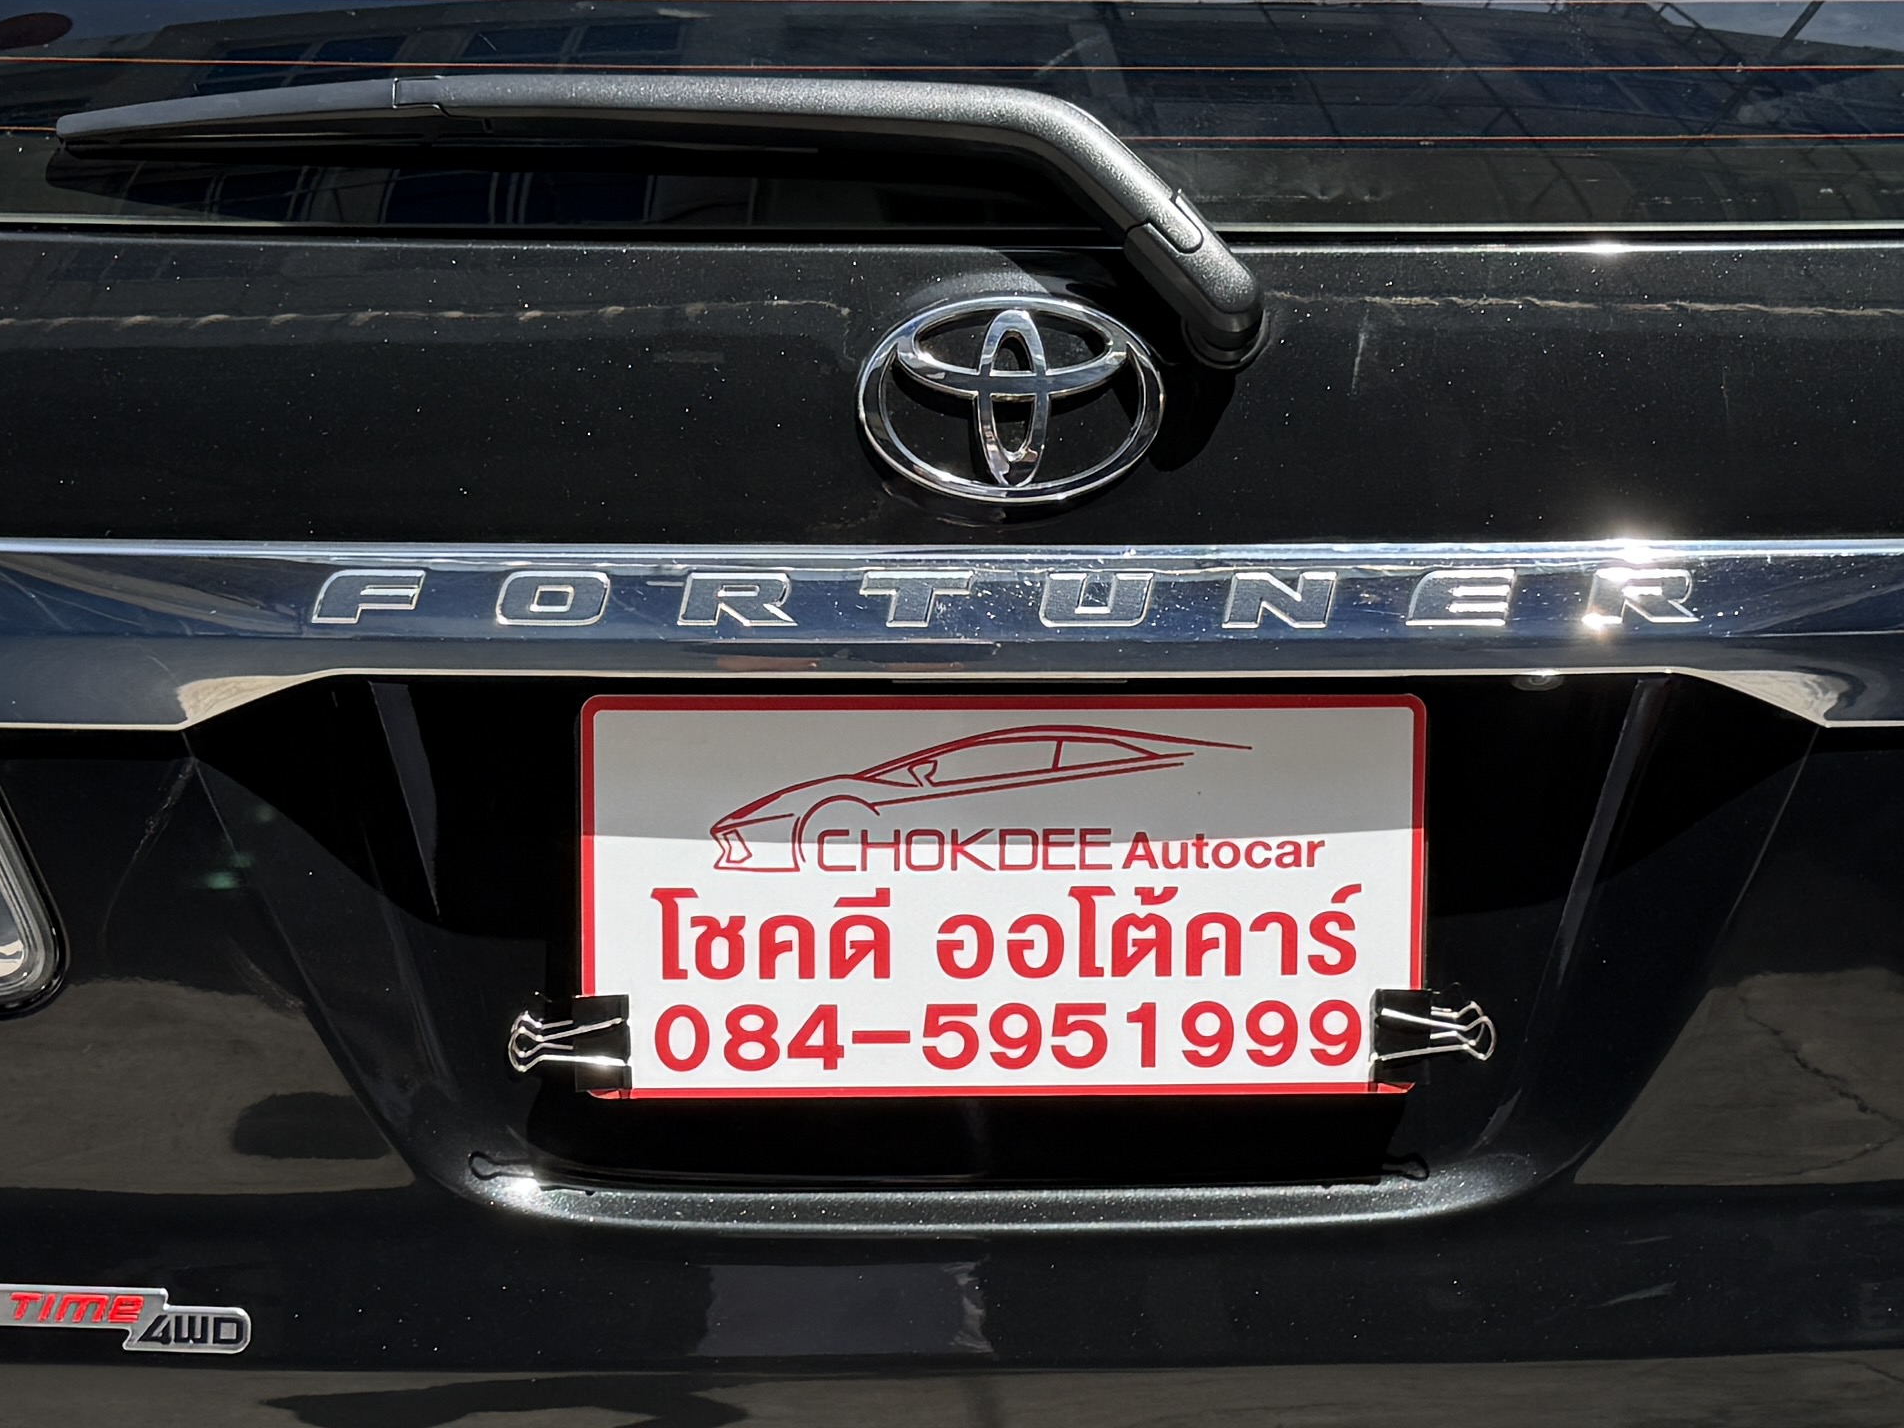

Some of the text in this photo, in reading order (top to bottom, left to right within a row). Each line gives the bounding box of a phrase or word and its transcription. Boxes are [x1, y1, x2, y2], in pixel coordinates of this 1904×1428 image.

[308, 565, 1700, 628] FORTUNER
[816, 827, 1326, 873] CHOKDEE Autocar
[650, 882, 1364, 981] โชคดี ออโต้คาร์
[653, 1000, 1363, 1073] 084-5951999
[135, 1314, 246, 1345] 4WD
